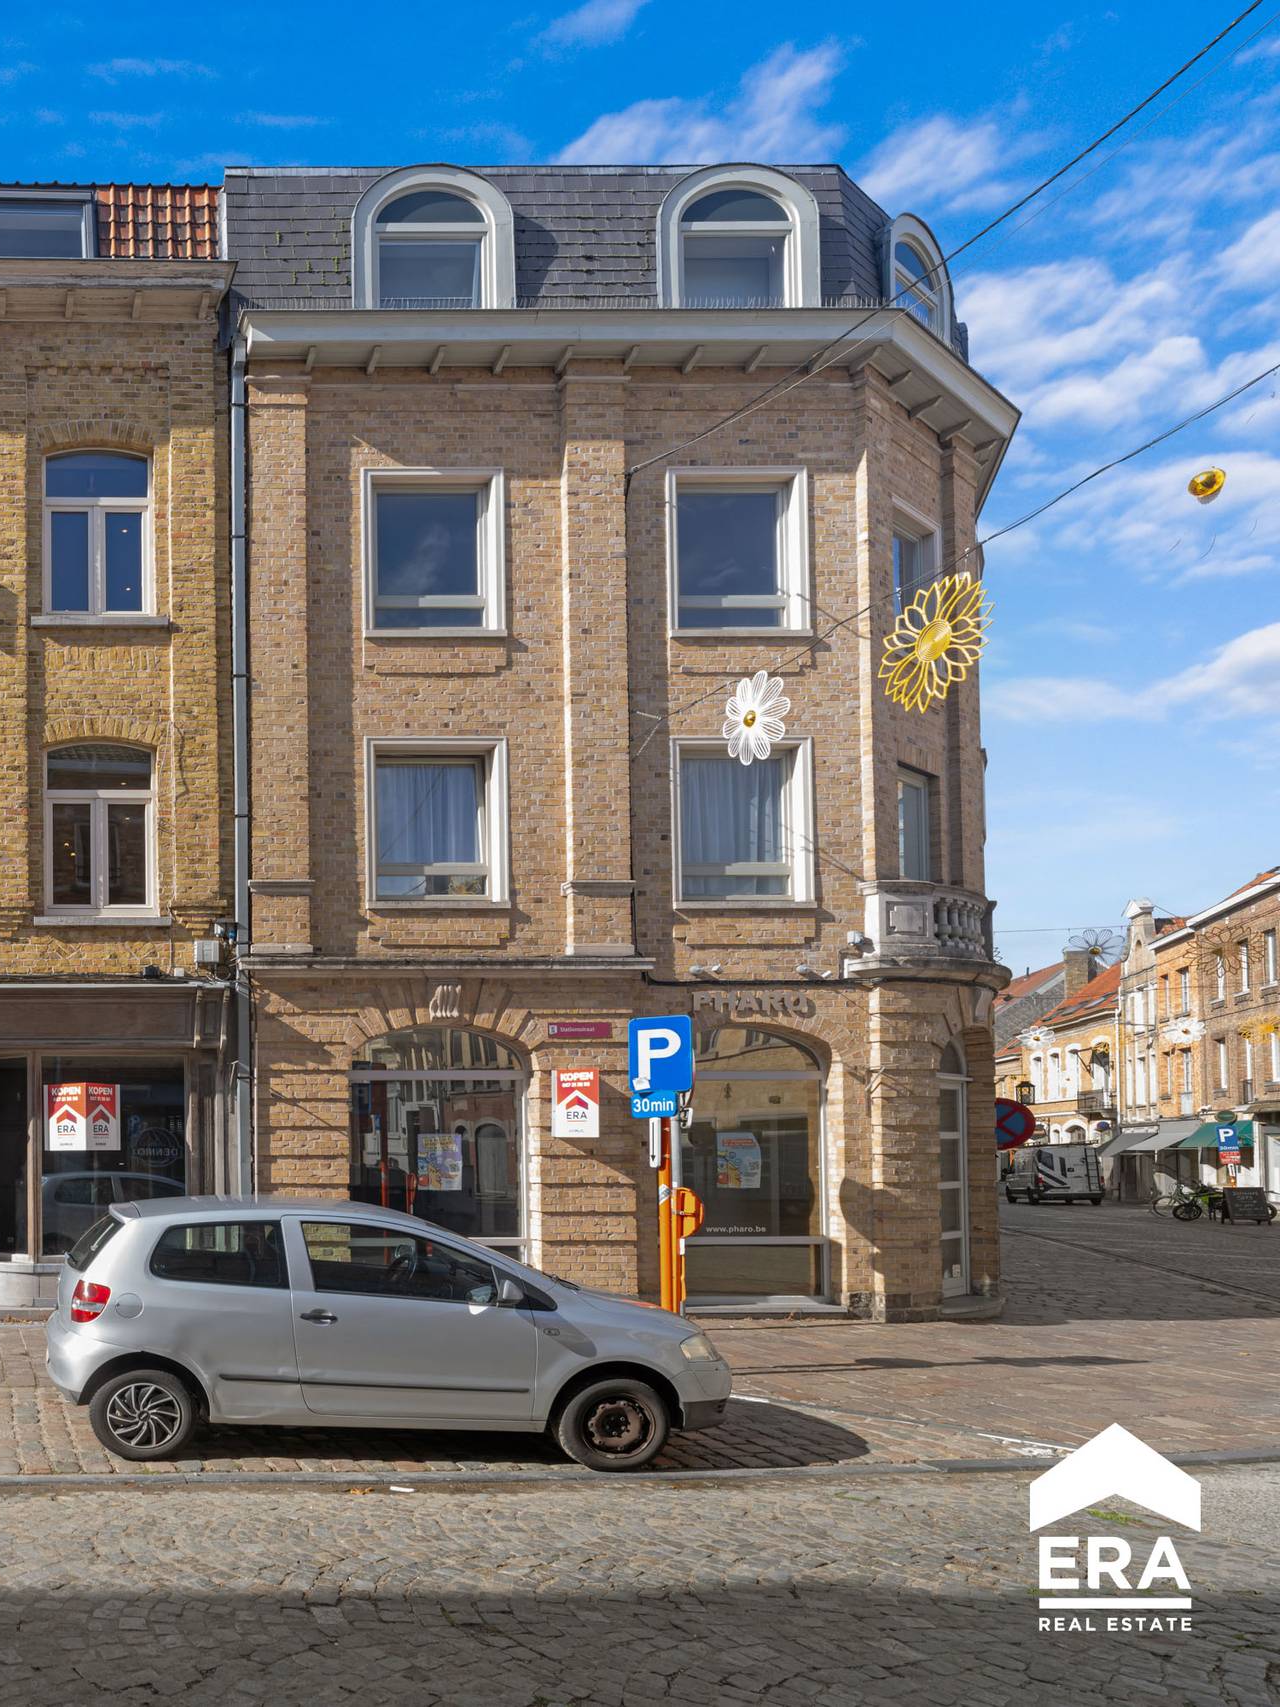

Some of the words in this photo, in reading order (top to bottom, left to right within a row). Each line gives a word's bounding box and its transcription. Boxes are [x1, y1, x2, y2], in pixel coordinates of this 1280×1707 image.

[637, 1028, 682, 1081] P
[560, 1072, 594, 1081] KOPEN
[51, 1086, 82, 1096] KOPEN
[88, 1086, 113, 1095] KOPEN
[633, 1098, 674, 1114] 30min
[566, 1112, 588, 1120] ERA
[57, 1125, 77, 1134] ERA
[93, 1124, 110, 1133] ERA
[1219, 1128, 1234, 1143] P
[705, 1225, 767, 1234] www.pharo.be
